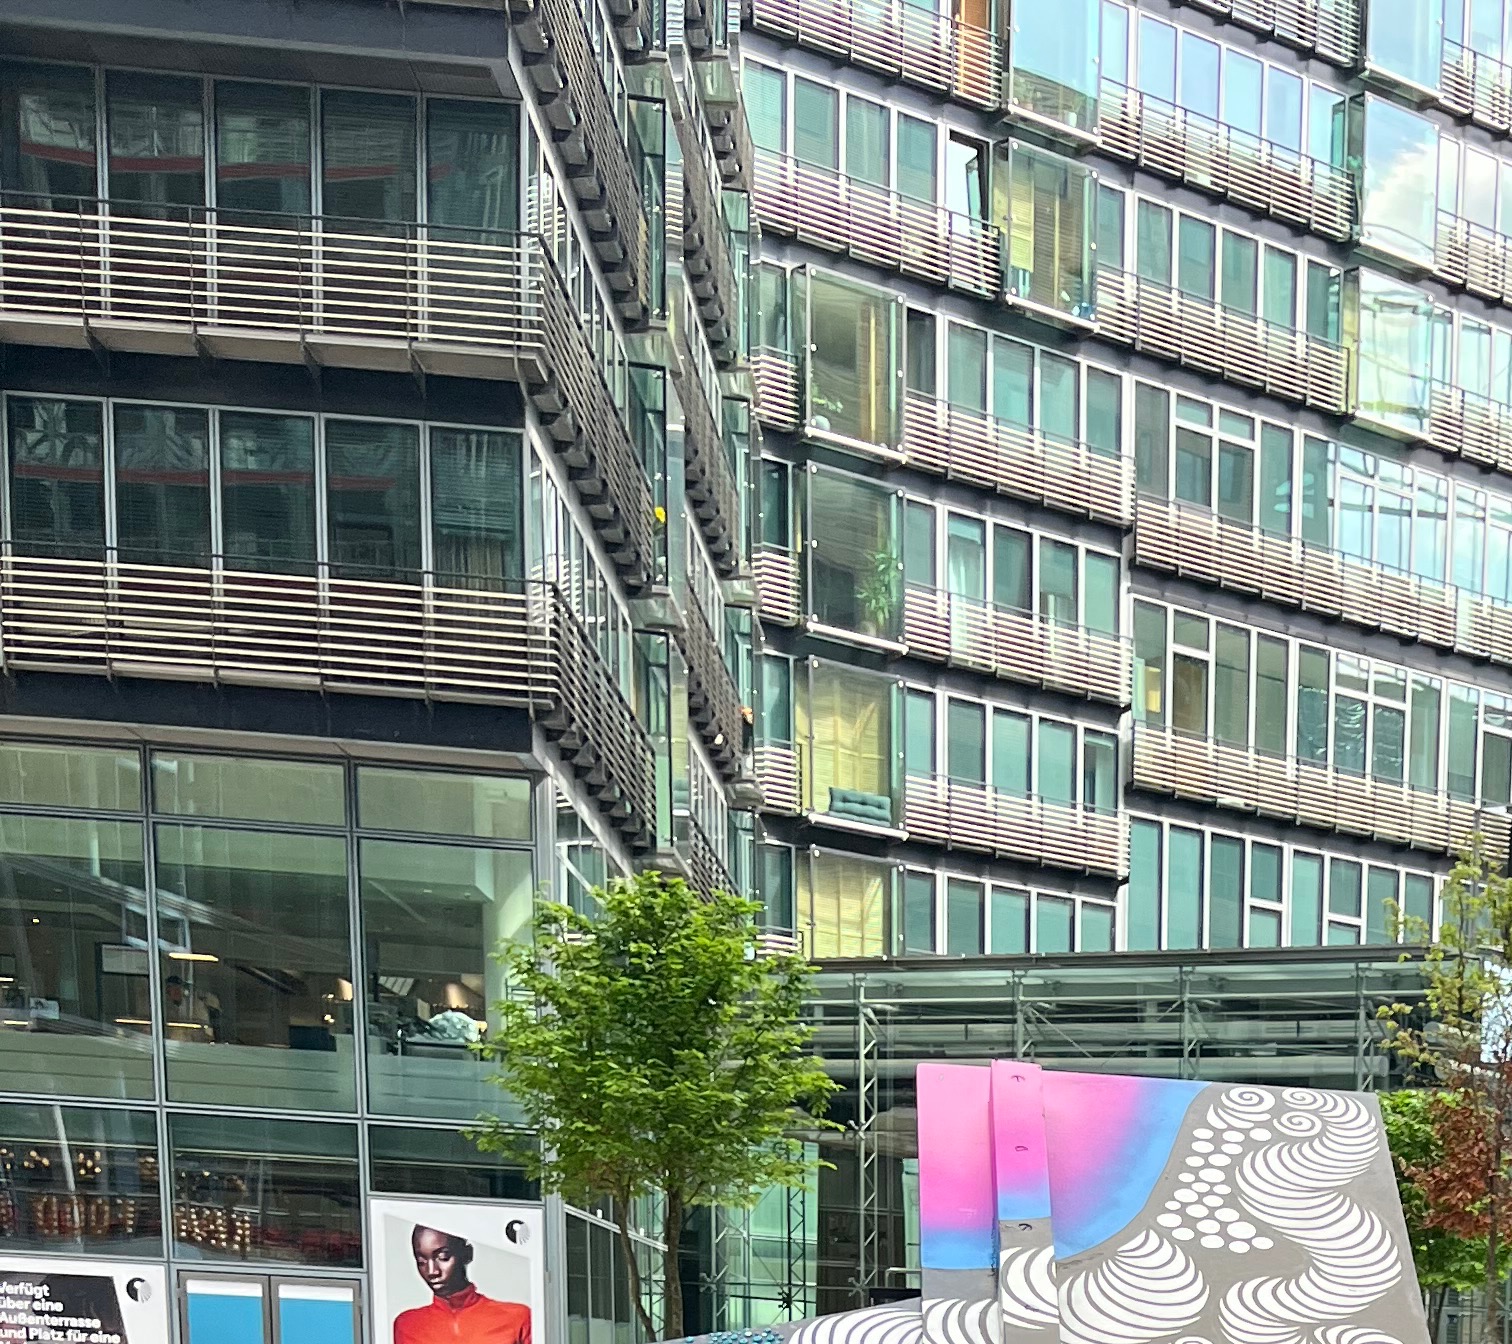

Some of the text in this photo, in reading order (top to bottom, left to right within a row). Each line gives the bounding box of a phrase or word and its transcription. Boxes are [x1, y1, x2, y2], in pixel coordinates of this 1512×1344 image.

[32, 1298, 64, 1312] eine
[0, 1311, 101, 1329] Außenterrasse
[0, 1326, 121, 1344] und Platz für eine
